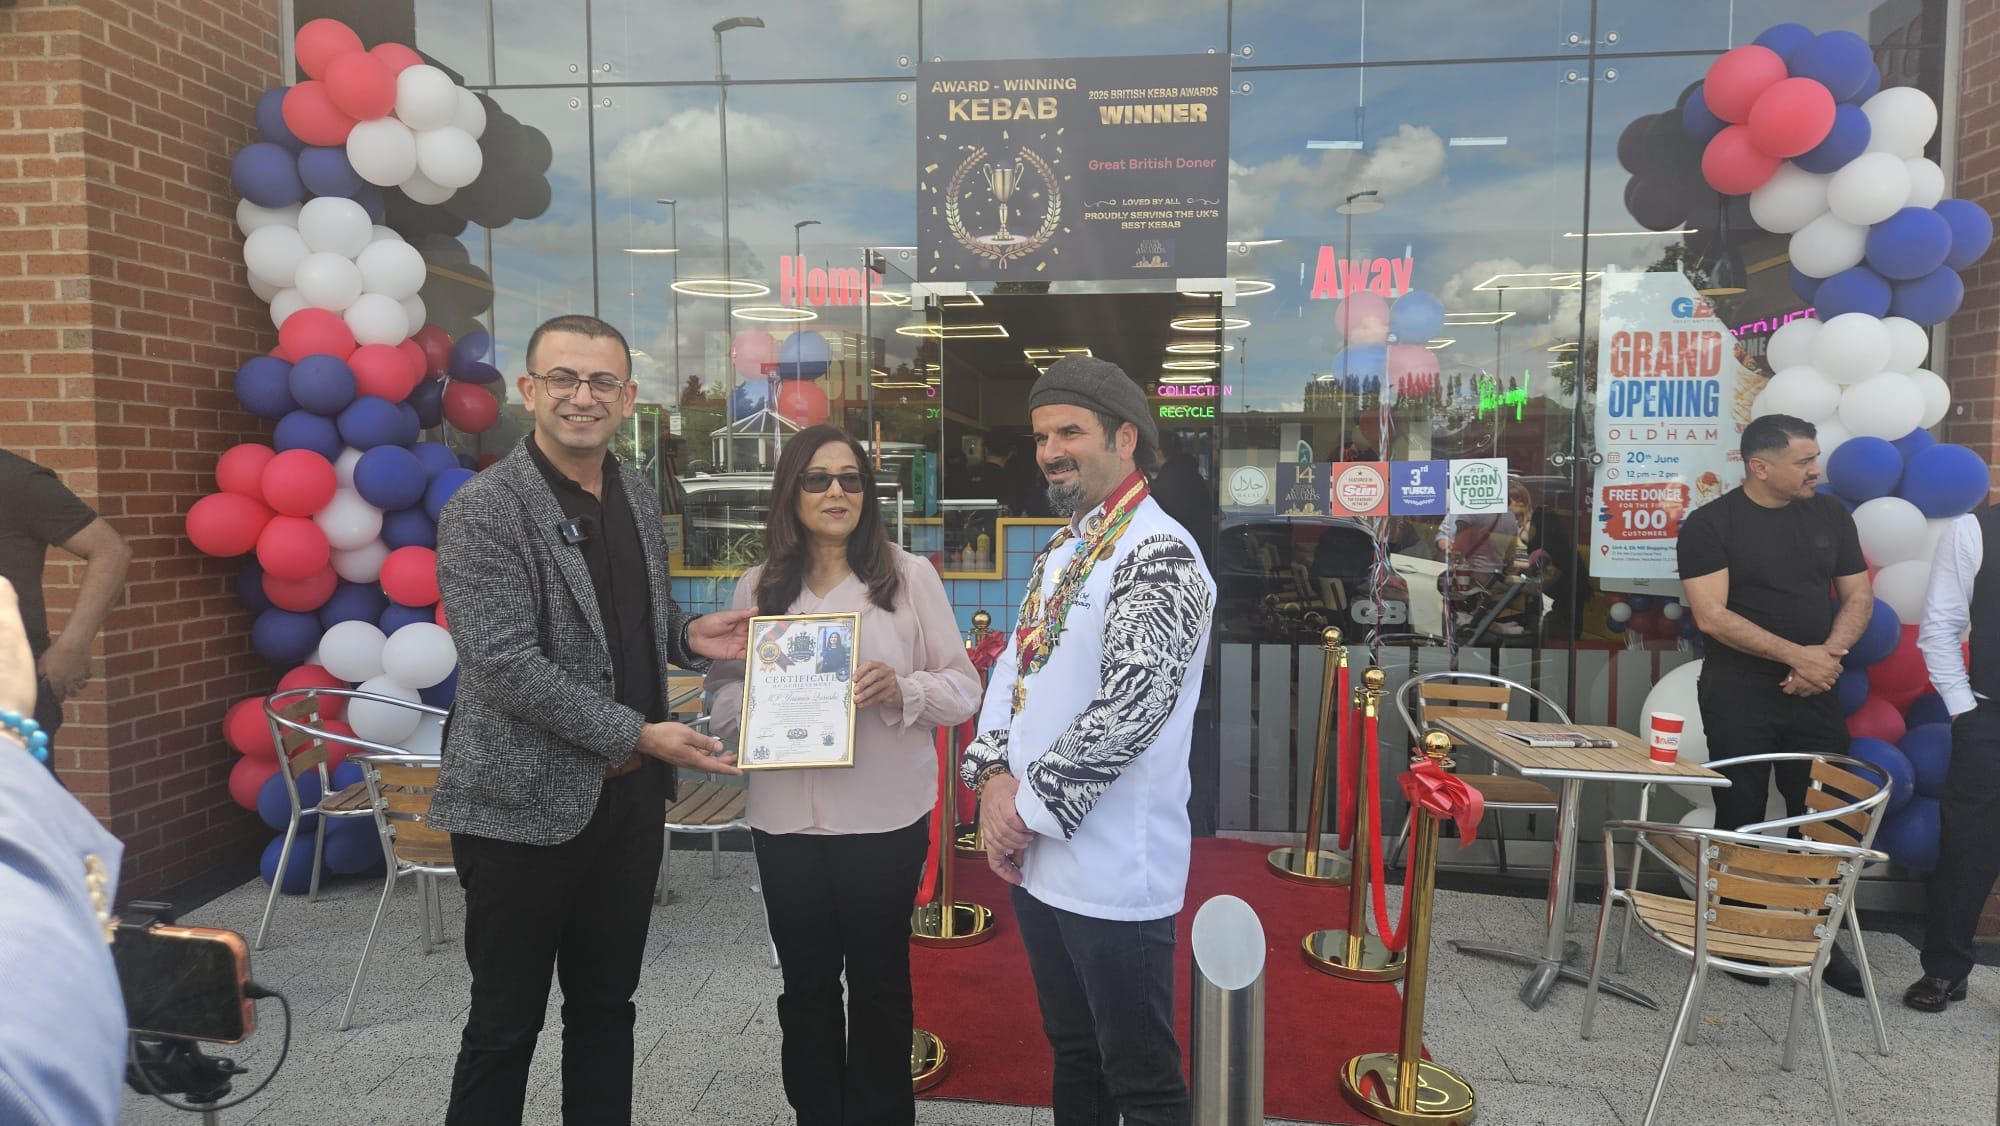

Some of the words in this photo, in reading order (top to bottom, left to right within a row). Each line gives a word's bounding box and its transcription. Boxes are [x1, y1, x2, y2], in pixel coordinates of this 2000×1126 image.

[931, 79, 990, 93] AWARD
[1004, 78, 1077, 92] WINNING
[1110, 88, 1146, 100] BRITISH
[1147, 88, 1178, 98] KEBAB
[1179, 86, 1219, 98] AWARDS
[948, 97, 1059, 122] KEBAB
[1098, 103, 1208, 125] WINNER
[1088, 159, 1125, 171] Great
[1126, 157, 1172, 170] British
[1175, 157, 1217, 169] Doner
[1122, 198, 1151, 206] LOVED
[1152, 198, 1164, 206] BY
[1084, 212, 1129, 220] PROUDLY
[1130, 211, 1173, 219] SERVING
[1175, 210, 1194, 218] THE
[1196, 209, 1220, 218] UK'S
[1122, 222, 1147, 230] BEST
[1148, 220, 1182, 229] KEBAB
[1311, 246, 1414, 299] Away
[780, 255, 884, 307] Home
[1610, 331, 1723, 378] GRAND
[1158, 385, 1233, 396] COLLECTIN
[1608, 379, 1720, 418] OPENING
[1160, 406, 1215, 418] RECYCLE
[1608, 428, 1718, 441] OLDHAM
[1626, 452, 1652, 464] 20th
[1654, 454, 1680, 464] June
[1410, 464, 1429, 486] 3rd
[1454, 473, 1498, 486] VEGAN
[1626, 470, 1636, 478] 12
[1233, 476, 1264, 492] حلال
[1344, 485, 1377, 496] Sun
[1460, 486, 1494, 498] FOOD
[1608, 489, 1639, 501] FREE
[1641, 488, 1683, 500] DONER
[1622, 509, 1667, 530] 100
[1350, 600, 1407, 624] GB
